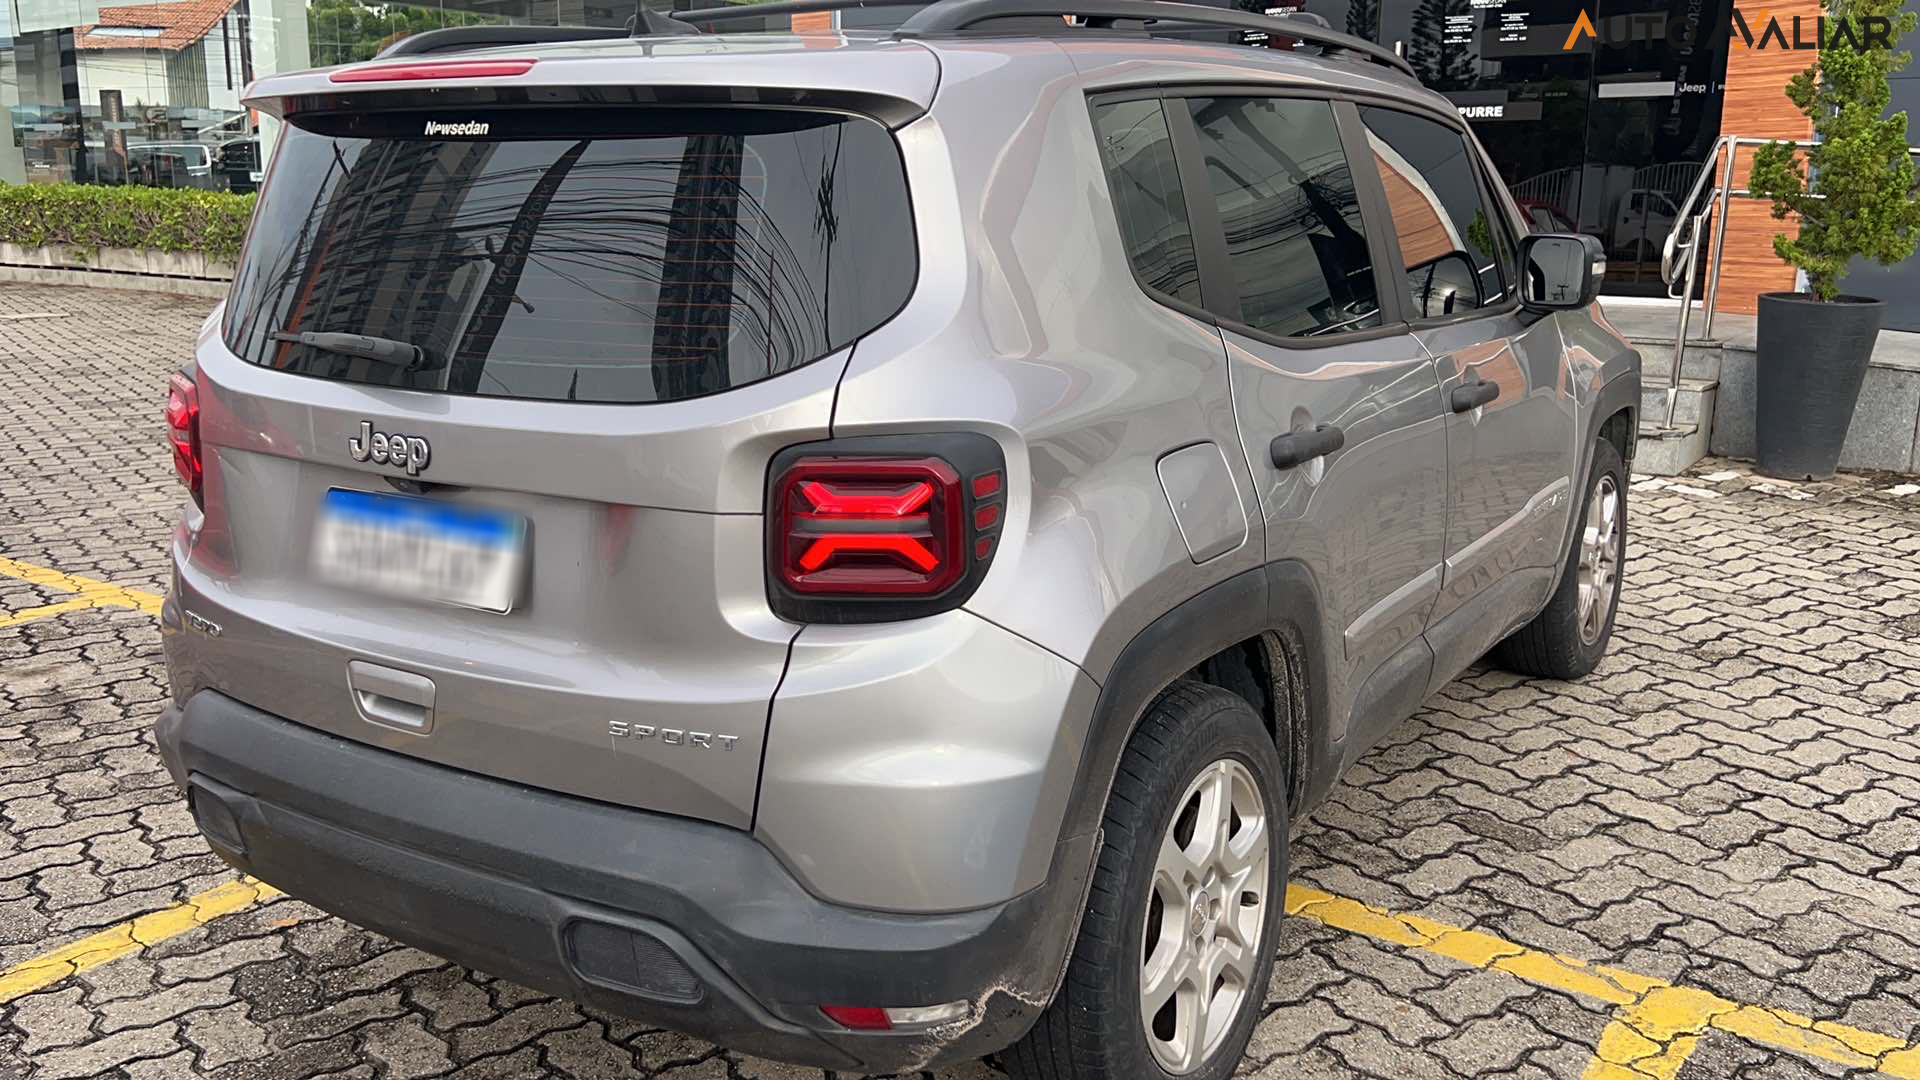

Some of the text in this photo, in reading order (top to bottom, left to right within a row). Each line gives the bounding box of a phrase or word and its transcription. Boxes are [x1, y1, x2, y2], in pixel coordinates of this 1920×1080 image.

[1679, 82, 1706, 93] Jeep
[424, 119, 490, 136] Newsedan
[348, 420, 431, 477] Jeep
[608, 719, 739, 751] SPORT
